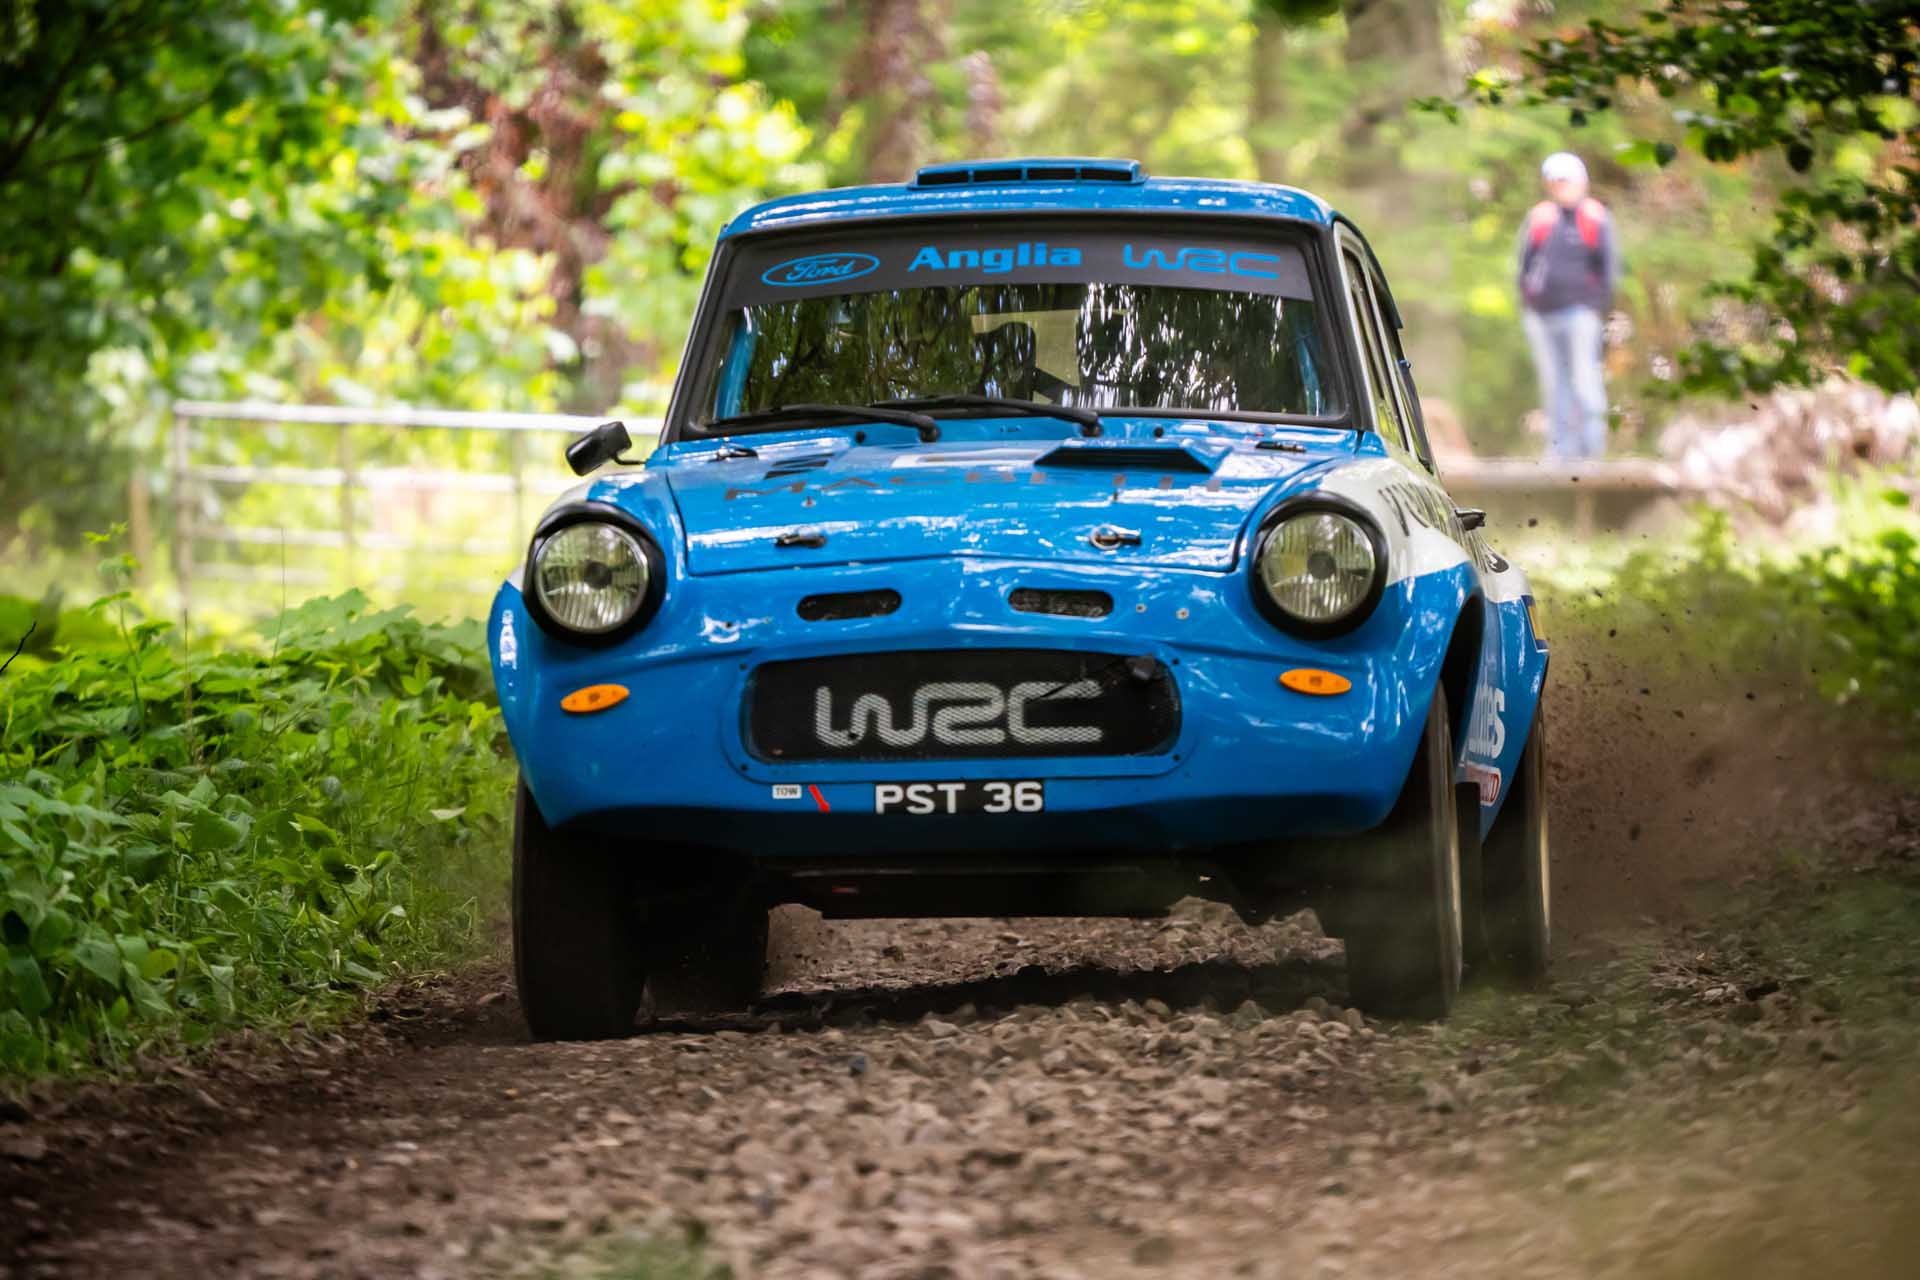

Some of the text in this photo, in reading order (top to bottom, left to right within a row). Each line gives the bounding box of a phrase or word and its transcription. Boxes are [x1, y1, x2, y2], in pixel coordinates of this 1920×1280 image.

[785, 258, 857, 281] Ford
[908, 243, 1280, 278] Anglia WRC
[815, 680, 1102, 748] WRC
[776, 787, 798, 797] TOW
[875, 781, 1044, 815] PST 36
